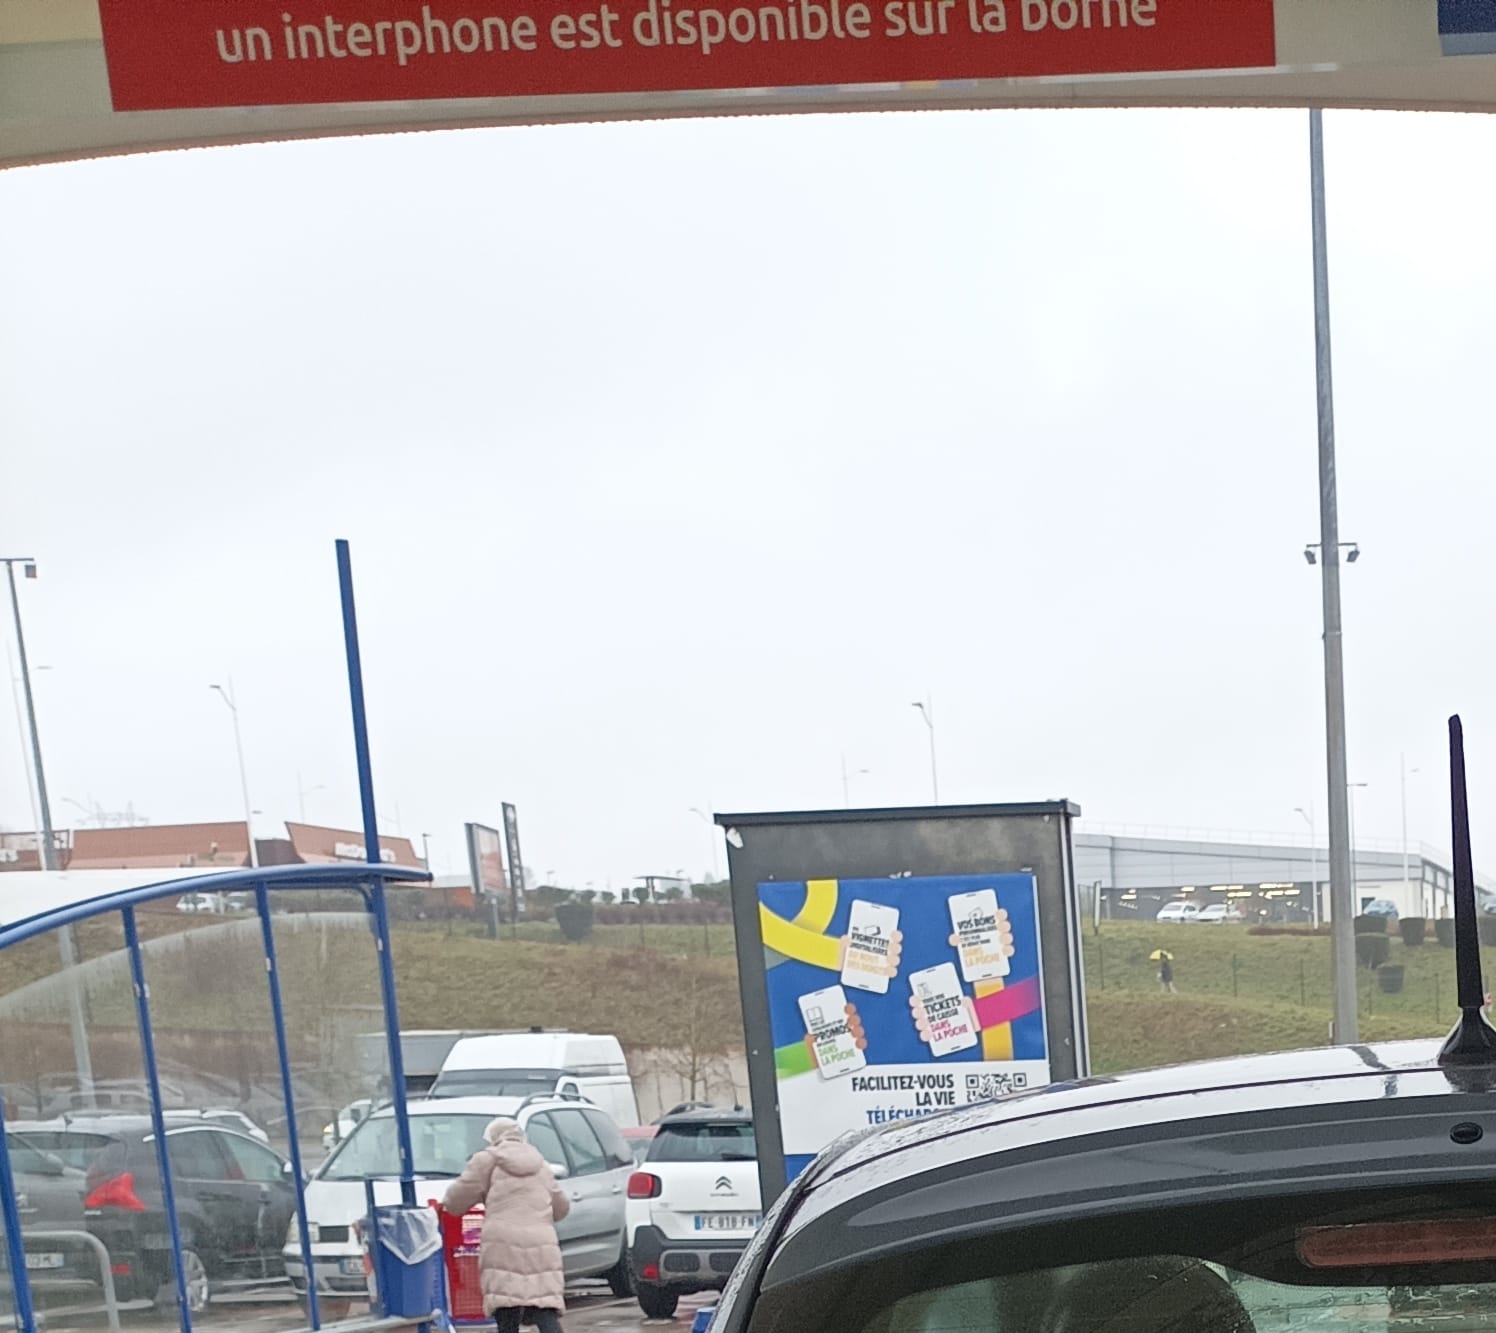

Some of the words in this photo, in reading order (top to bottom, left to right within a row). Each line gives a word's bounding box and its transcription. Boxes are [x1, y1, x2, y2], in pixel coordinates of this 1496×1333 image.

[216, 26, 272, 62] un
[282, 5, 537, 66] interphone
[550, 6, 622, 49] est
[632, 0, 871, 54] disponible
[885, 1, 955, 37] sur
[968, 0, 1007, 33] la
[1021, 0, 1158, 31] borne
[924, 995, 961, 1015] TICKETS
[851, 1074, 955, 1092] FACILITEZ-VOUS
[915, 1091, 932, 1106] LA
[933, 1090, 956, 1105] VIE
